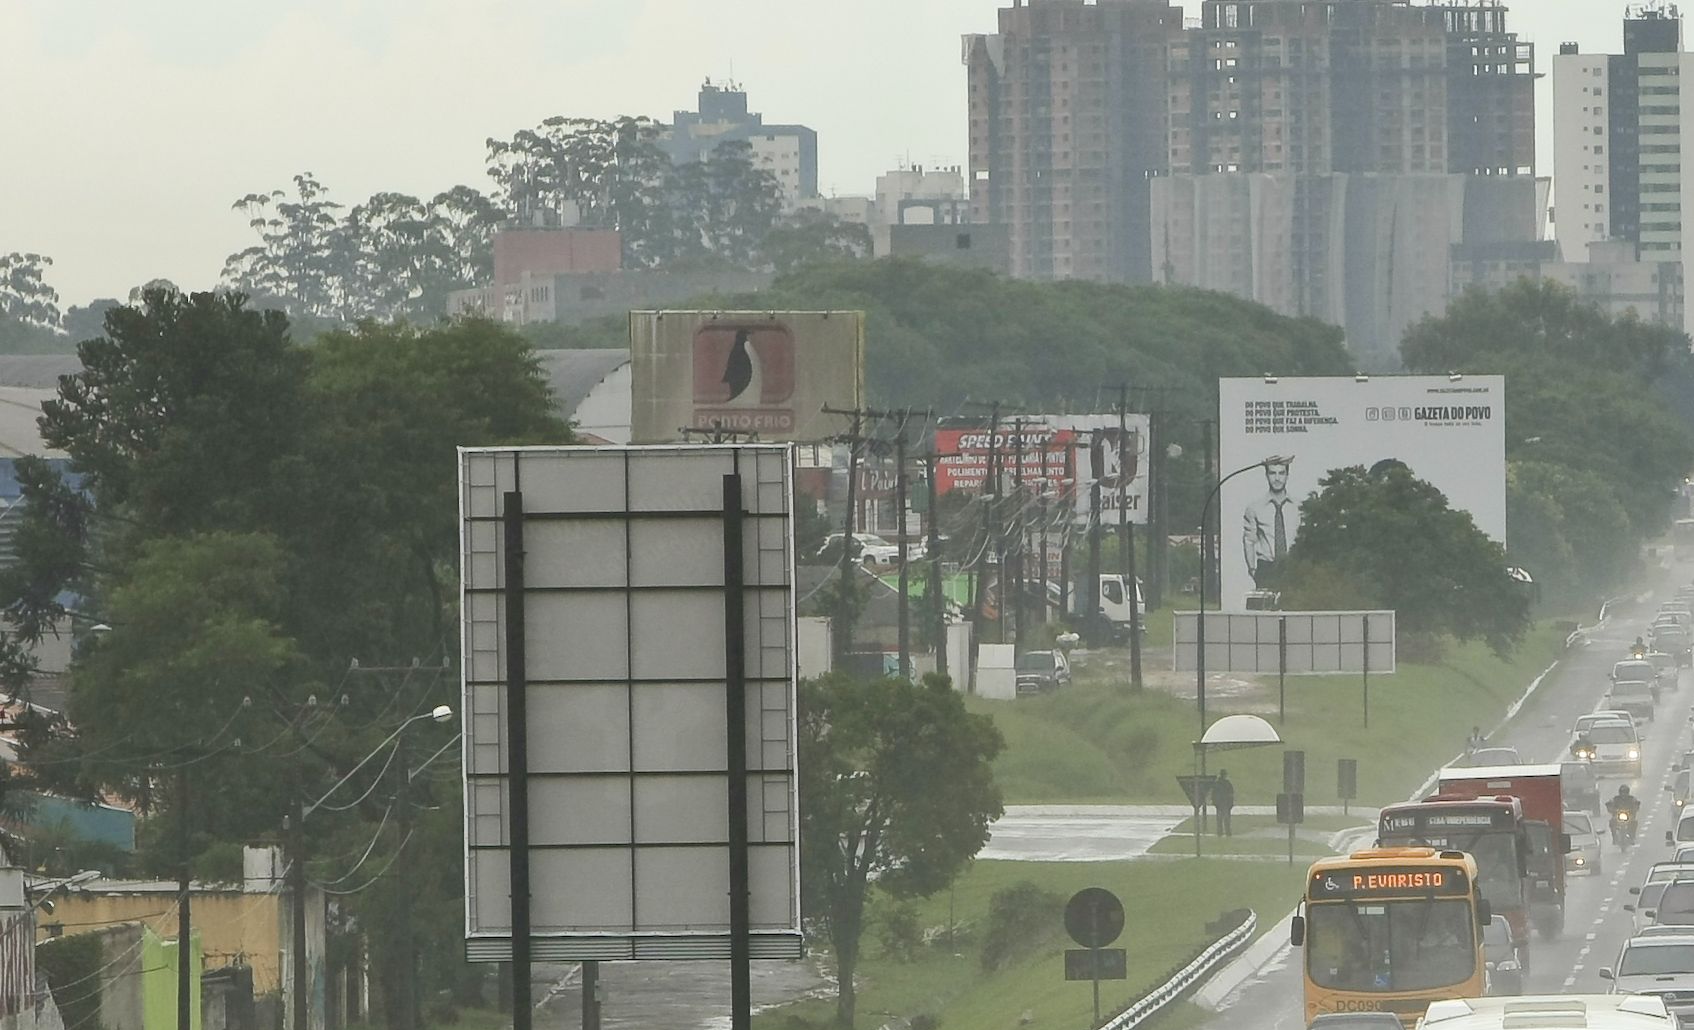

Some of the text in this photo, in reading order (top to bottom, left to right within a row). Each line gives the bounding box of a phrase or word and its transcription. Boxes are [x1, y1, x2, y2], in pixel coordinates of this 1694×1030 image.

[1414, 406, 1491, 420] GAZETA DO POVO
[1100, 494, 1141, 511] aiser
